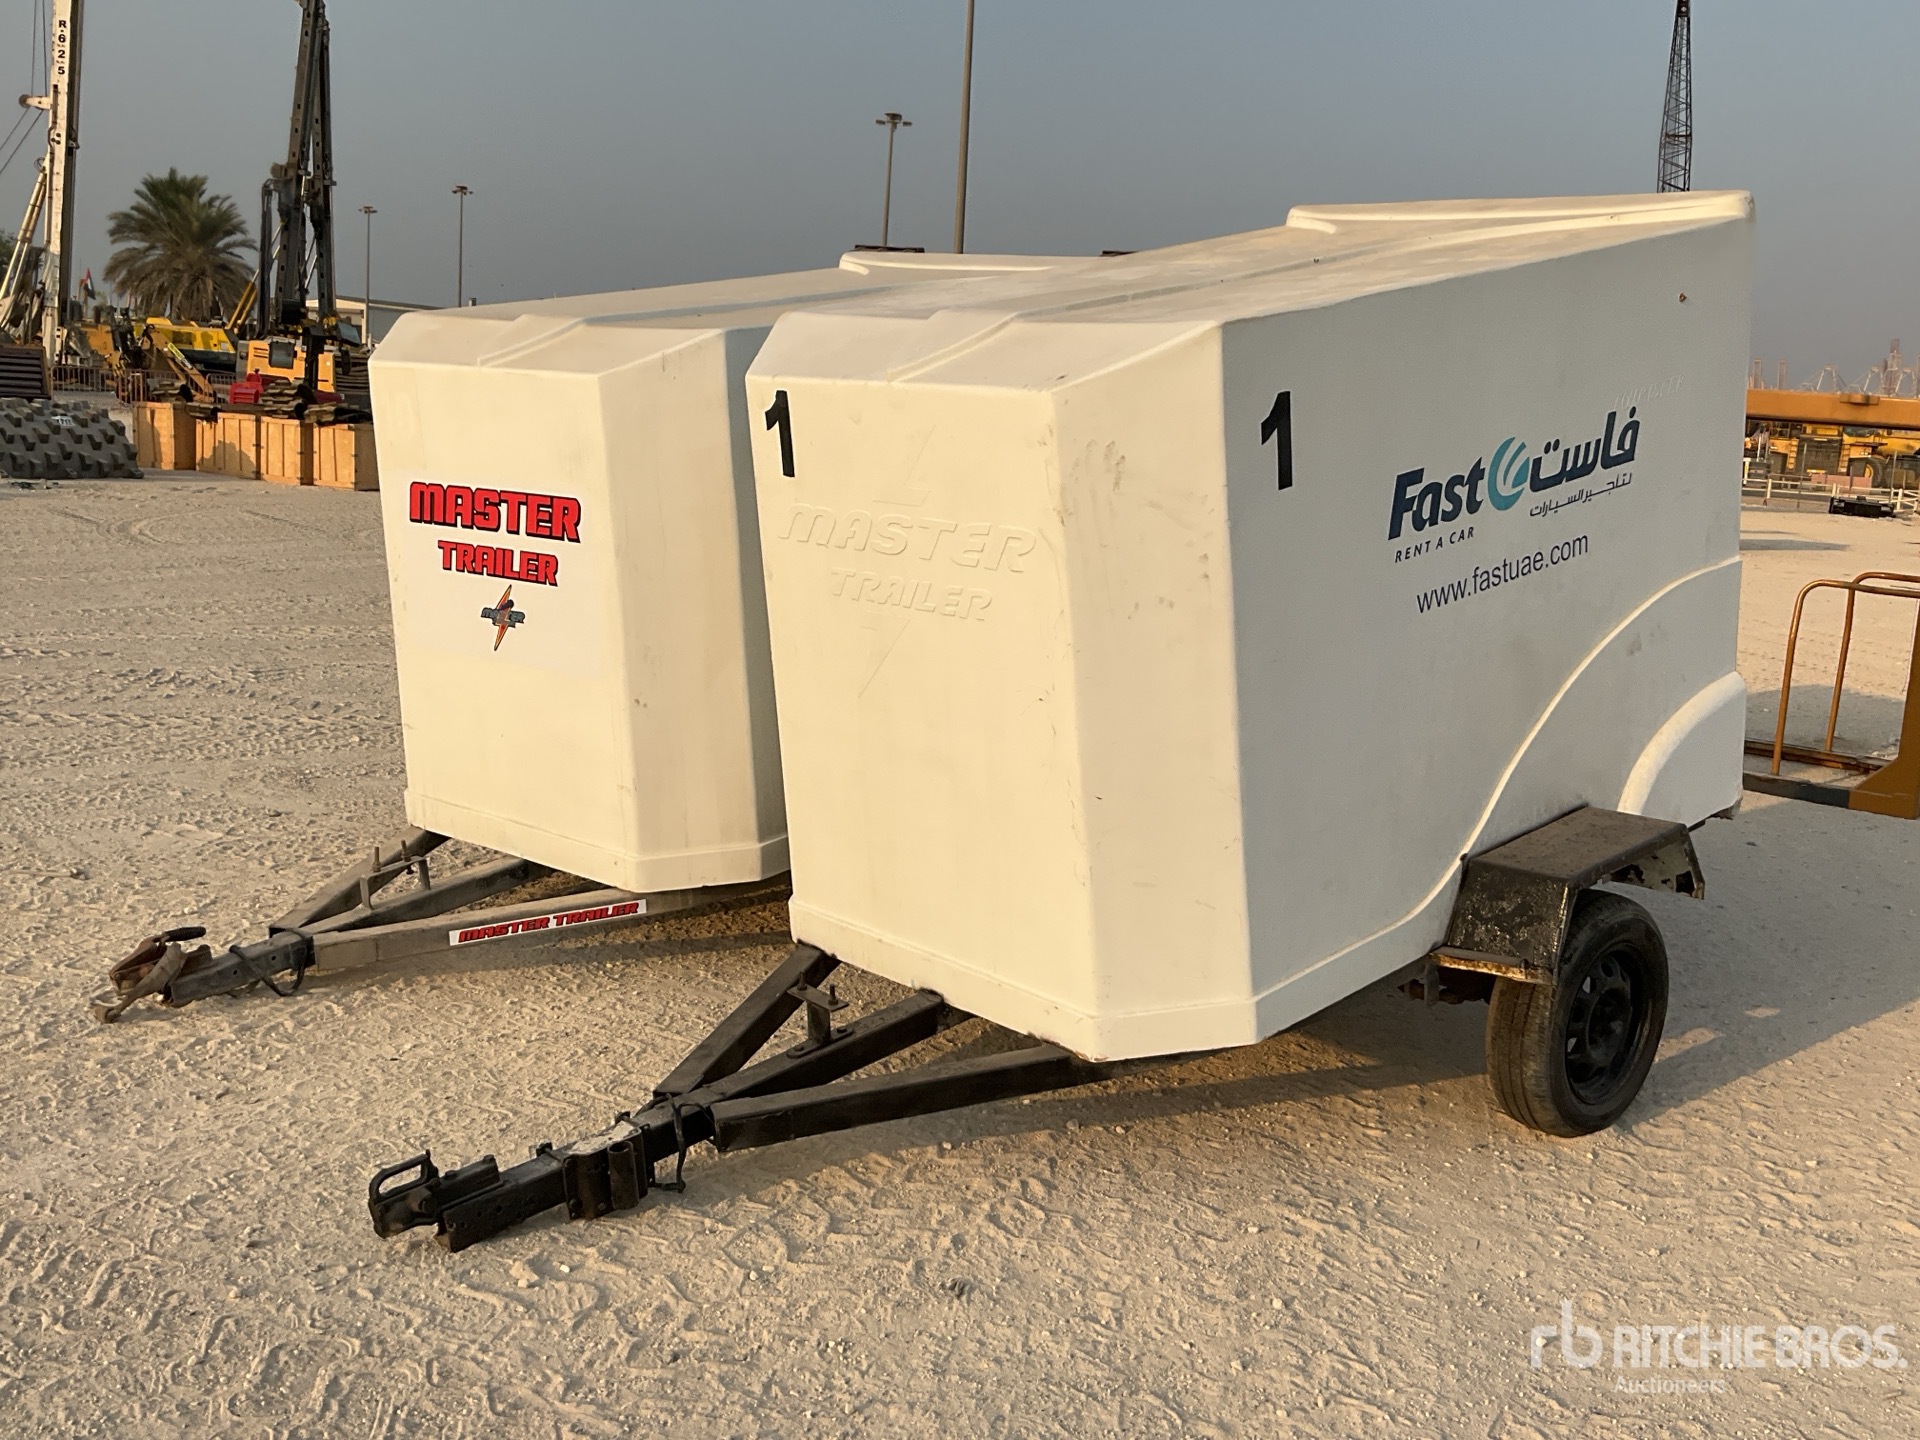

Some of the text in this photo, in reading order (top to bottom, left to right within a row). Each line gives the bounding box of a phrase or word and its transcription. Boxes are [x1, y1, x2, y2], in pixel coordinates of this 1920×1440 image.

[764, 389, 795, 478] 1
[1260, 390, 1293, 491] 1
[1529, 405, 1641, 493] فاست
[409, 481, 582, 544] MASTER
[1387, 456, 1486, 541] Fast
[437, 540, 559, 587] TRAILER
[778, 502, 1037, 573] MASTER
[1395, 526, 1475, 564] RENT A CAR
[831, 566, 992, 621] TRAILER
[1416, 533, 1589, 614] www.fastuae.com
[458, 901, 640, 943] MASTER TRAILER
